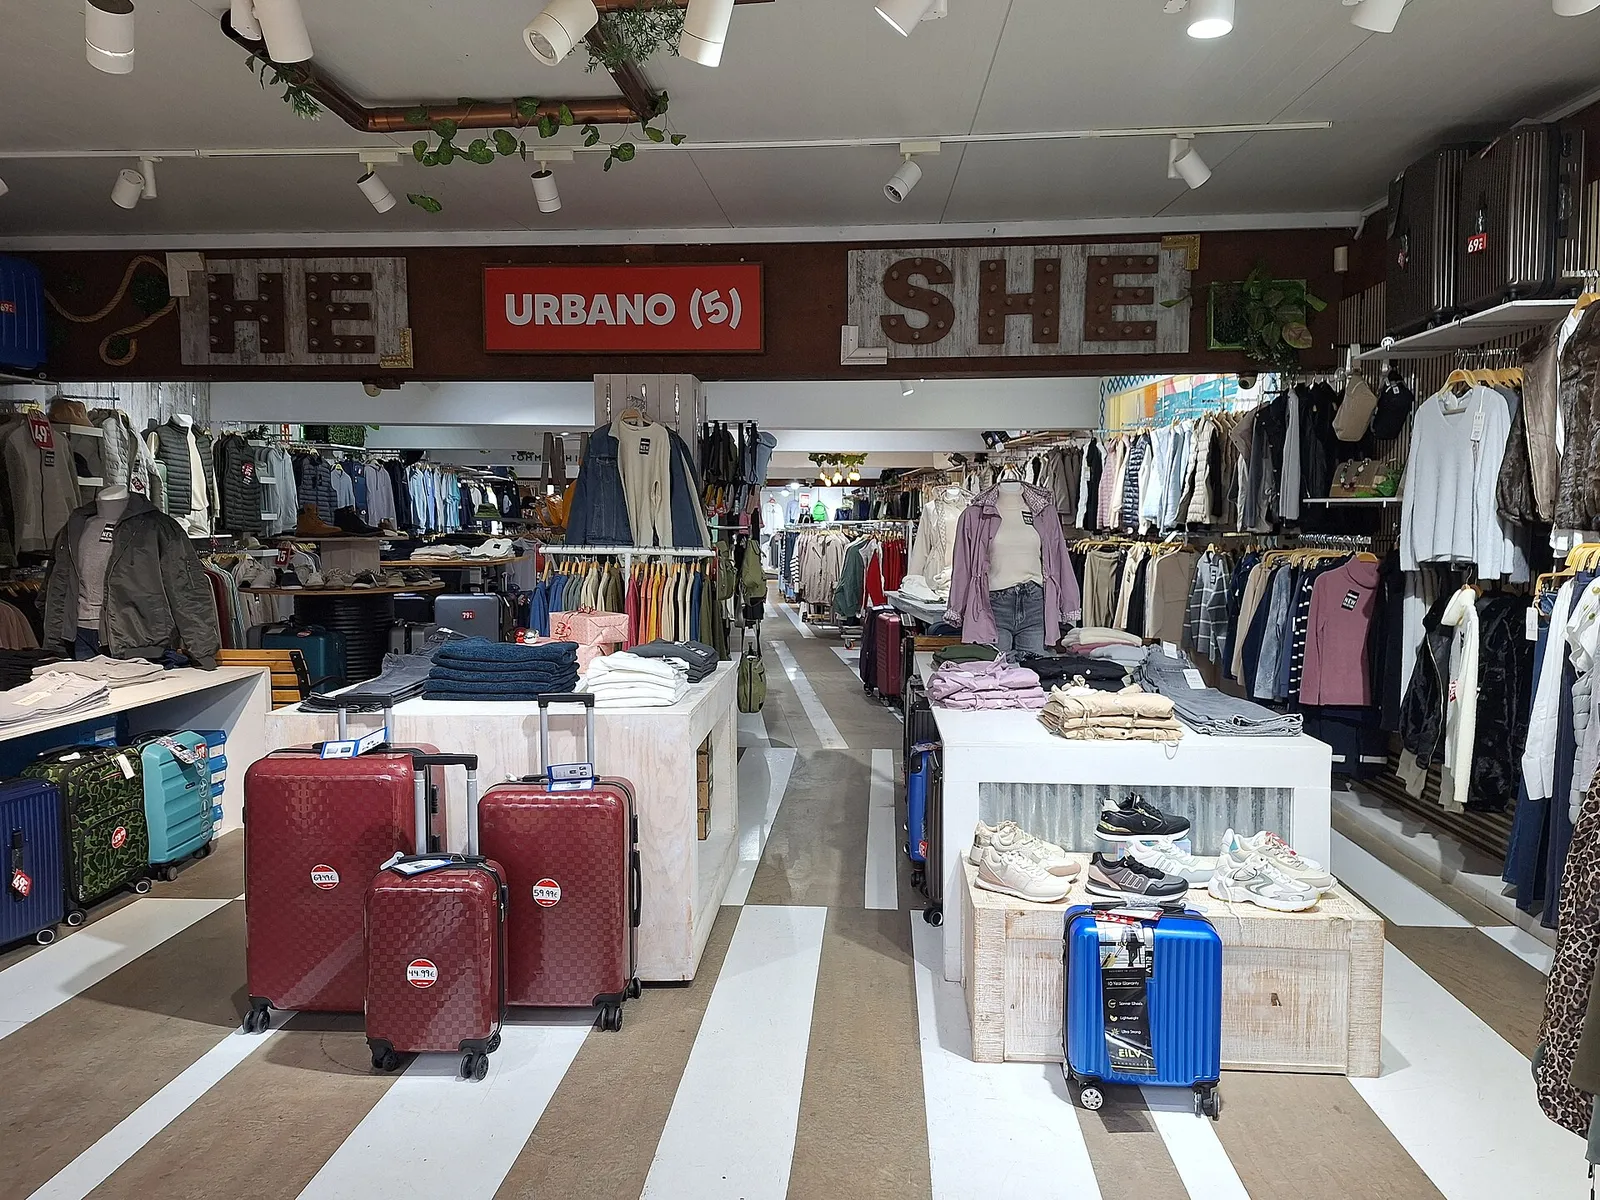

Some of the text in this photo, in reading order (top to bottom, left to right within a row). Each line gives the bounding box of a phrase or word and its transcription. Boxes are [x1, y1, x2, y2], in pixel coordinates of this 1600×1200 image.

[208, 272, 375, 353] HE
[504, 287, 742, 331] URBANO (5)
[880, 255, 1159, 345] SHE
[511, 454, 541, 462] TOMM
